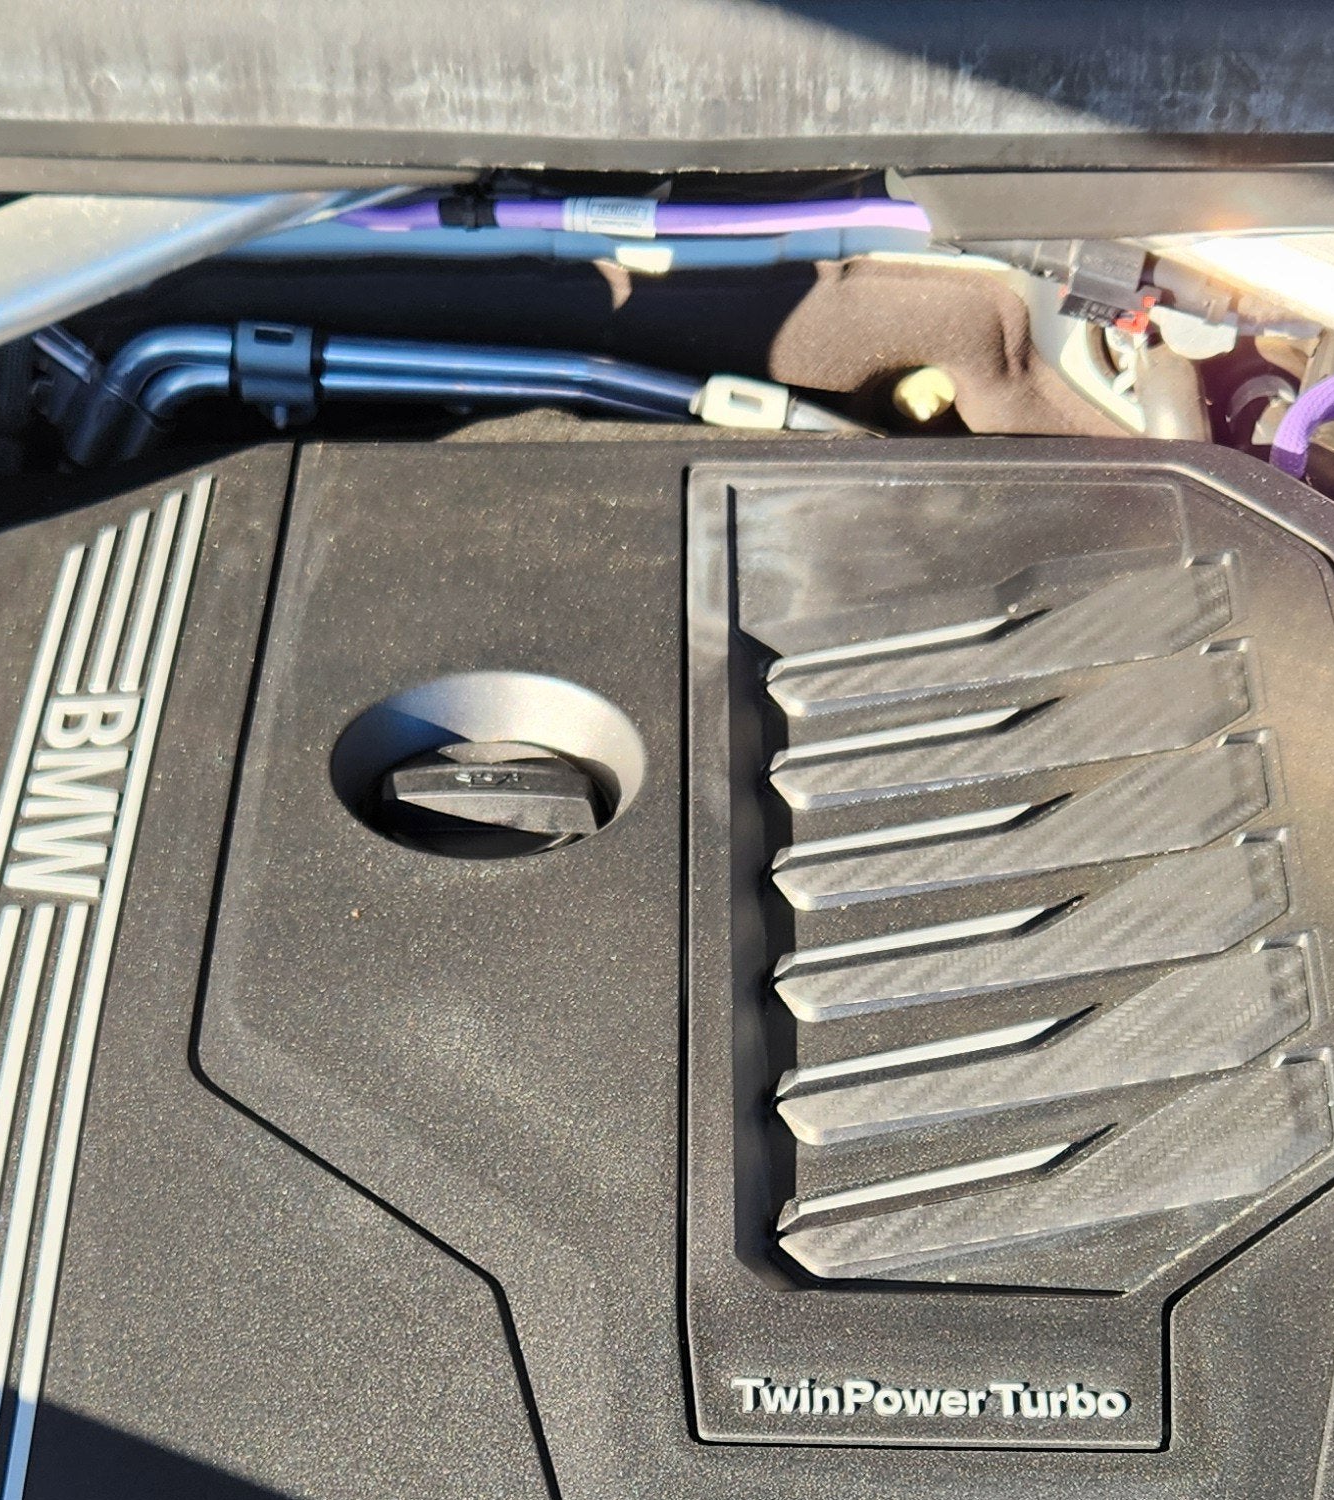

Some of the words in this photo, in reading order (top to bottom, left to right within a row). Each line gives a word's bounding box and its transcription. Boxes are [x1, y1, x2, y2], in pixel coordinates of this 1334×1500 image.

[3, 694, 142, 898] BMW
[731, 1377, 988, 1417] TwinPower
[989, 1381, 1128, 1419] Turbo
